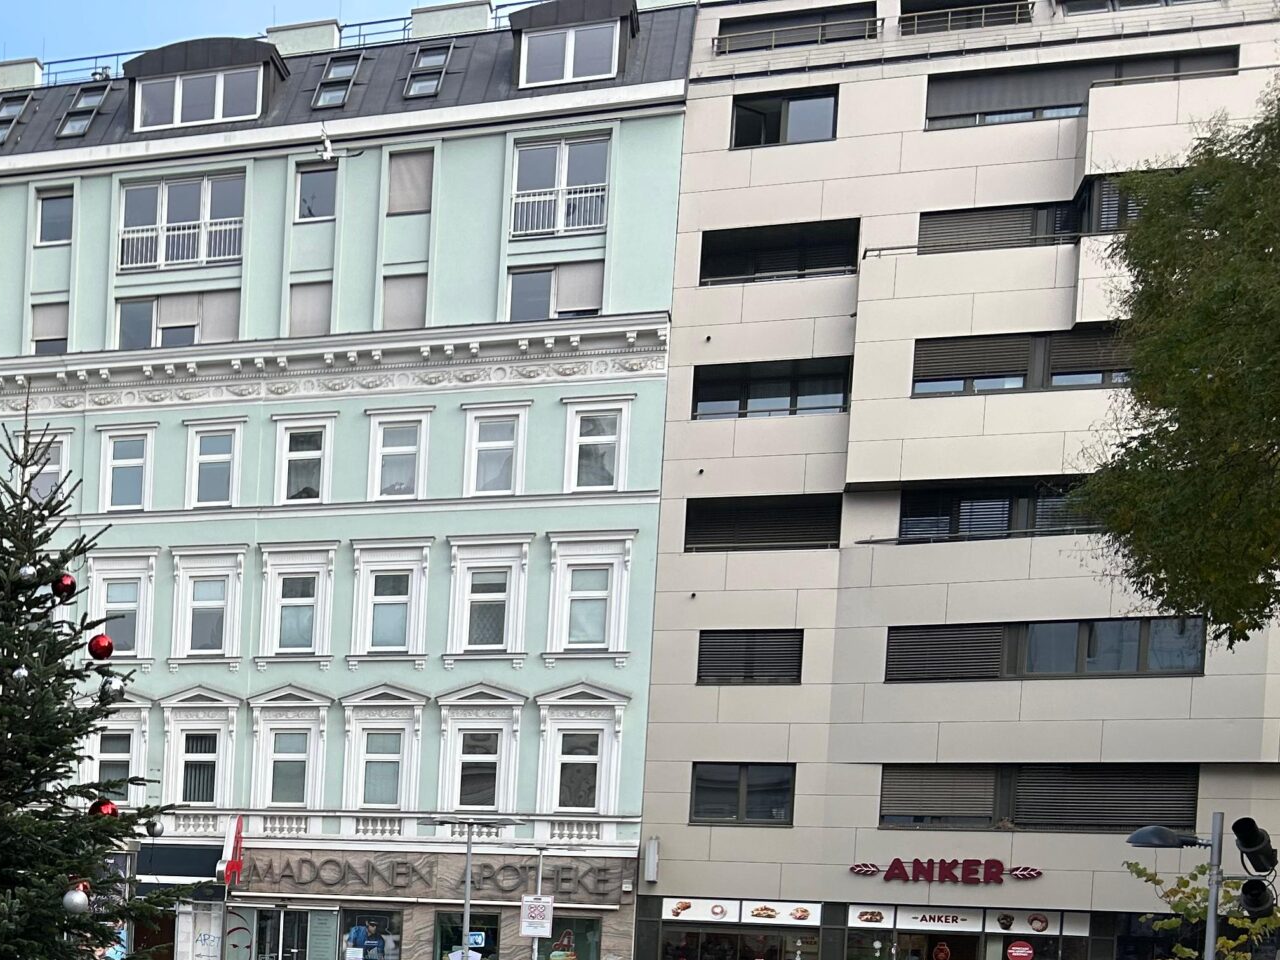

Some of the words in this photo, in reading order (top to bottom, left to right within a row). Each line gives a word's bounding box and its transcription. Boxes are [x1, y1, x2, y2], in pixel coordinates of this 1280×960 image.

[249, 857, 433, 888] MADONNEN
[455, 862, 610, 895] APOTHEKE
[883, 857, 1005, 884] ANKER
[919, 914, 959, 925] ANKER
